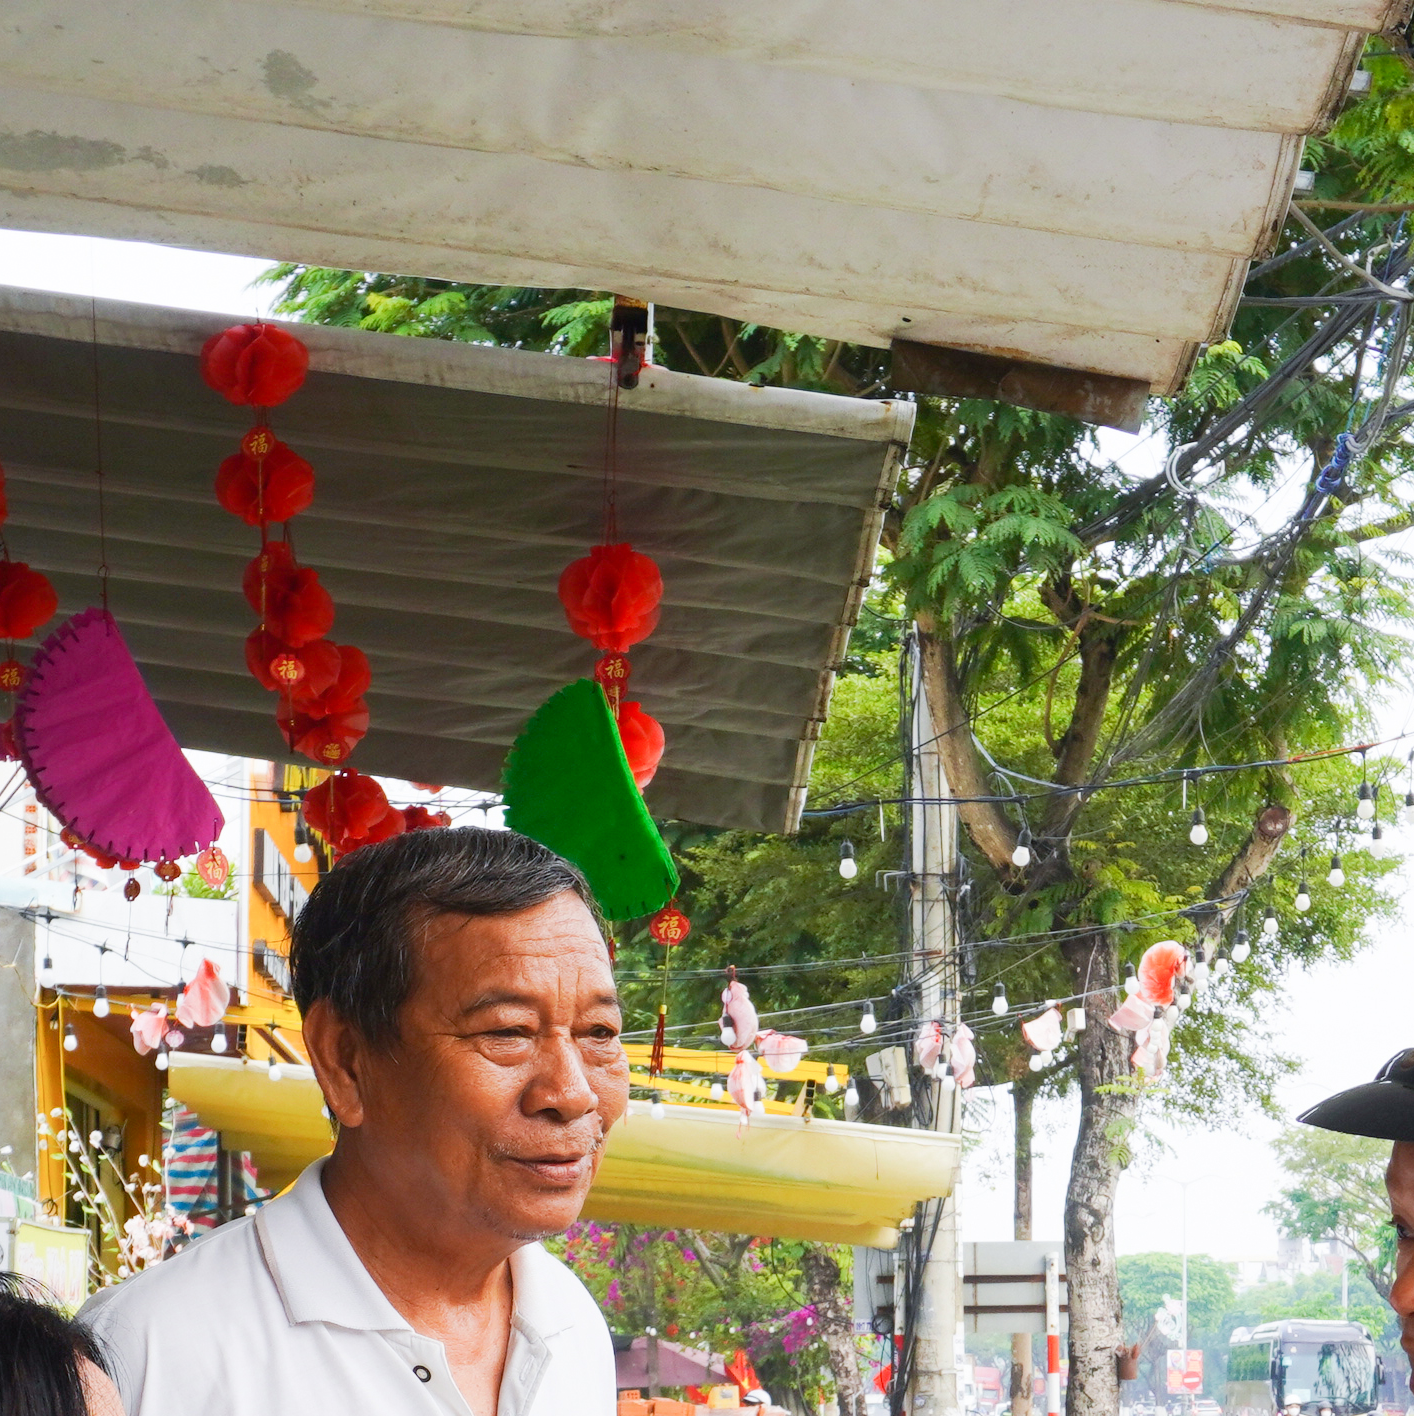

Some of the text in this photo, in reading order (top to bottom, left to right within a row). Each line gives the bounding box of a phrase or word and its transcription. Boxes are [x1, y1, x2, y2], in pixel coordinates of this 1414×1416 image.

[249, 432, 268, 455] 福
[0, 667, 21, 687] 福
[277, 659, 298, 680] 福
[604, 658, 625, 679] 福
[657, 913, 682, 939] 福
